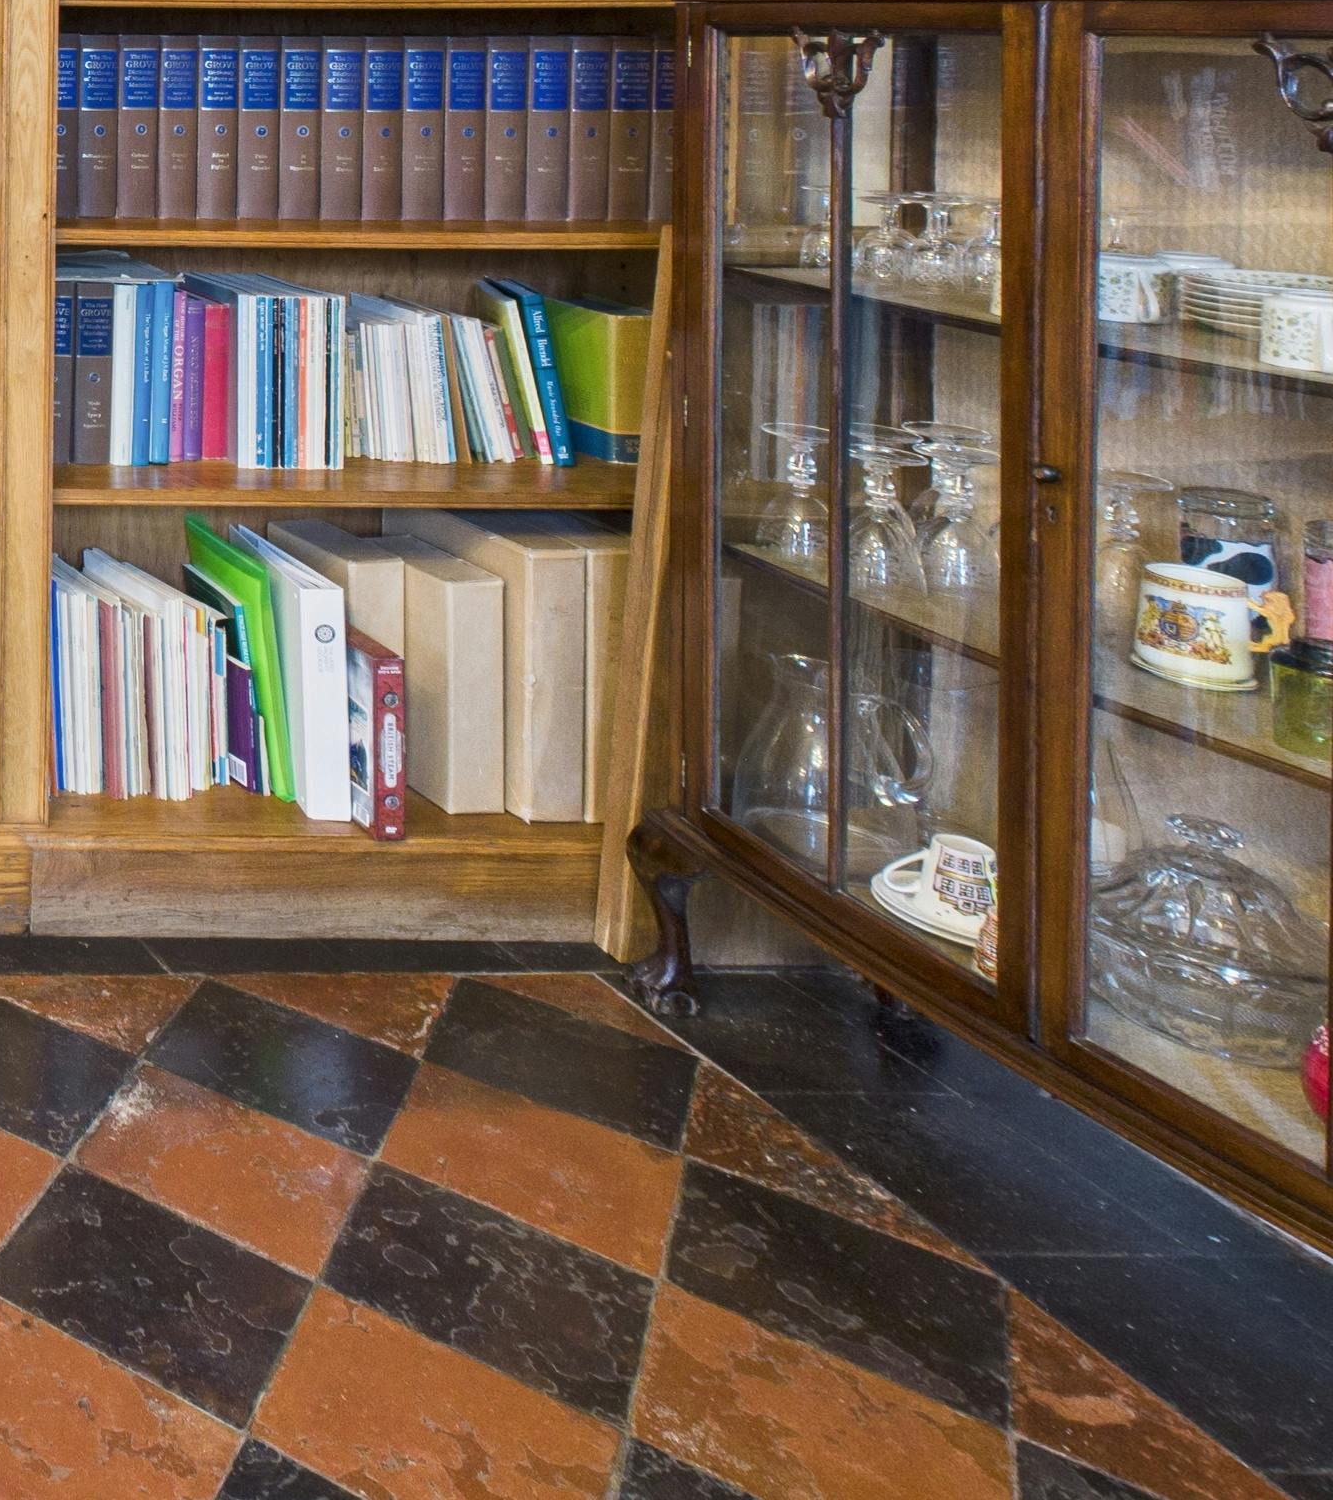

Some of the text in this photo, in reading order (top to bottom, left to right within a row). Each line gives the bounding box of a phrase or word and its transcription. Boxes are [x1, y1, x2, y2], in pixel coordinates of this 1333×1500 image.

[531, 309, 552, 367] Alfred Brendel
[173, 345, 184, 400] ORGAN
[385, 754, 398, 780] STEAM
